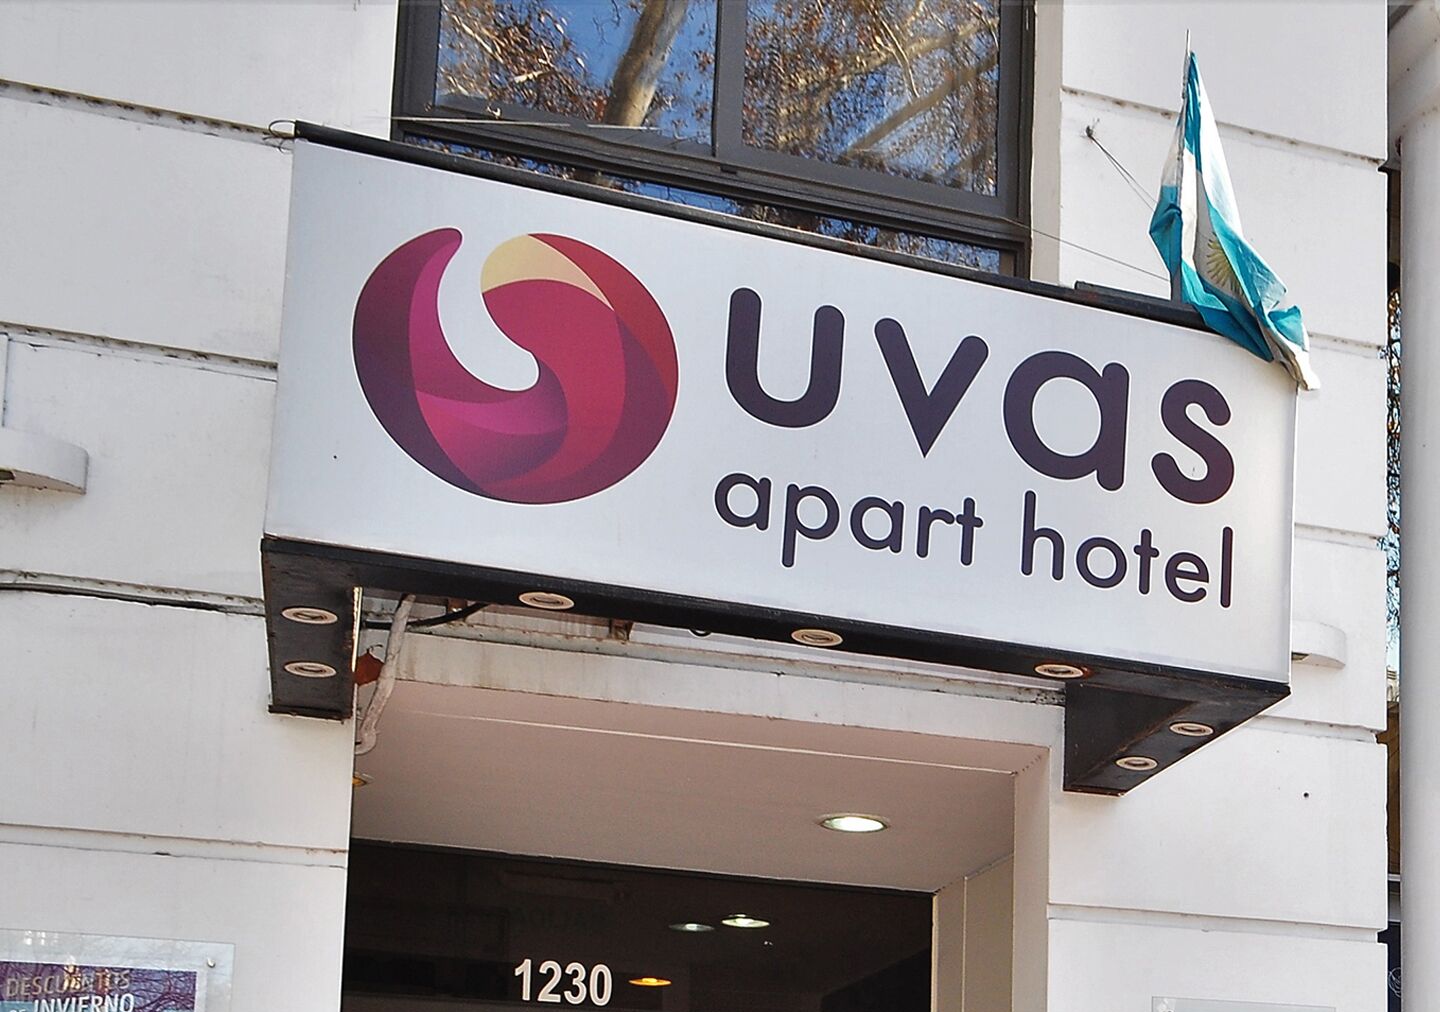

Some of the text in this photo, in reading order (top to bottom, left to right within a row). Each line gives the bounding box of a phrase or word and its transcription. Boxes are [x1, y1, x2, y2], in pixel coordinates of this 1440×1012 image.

[725, 286, 1235, 505] uvas
[714, 471, 1234, 609] apart hotel
[515, 959, 612, 1006] 1230
